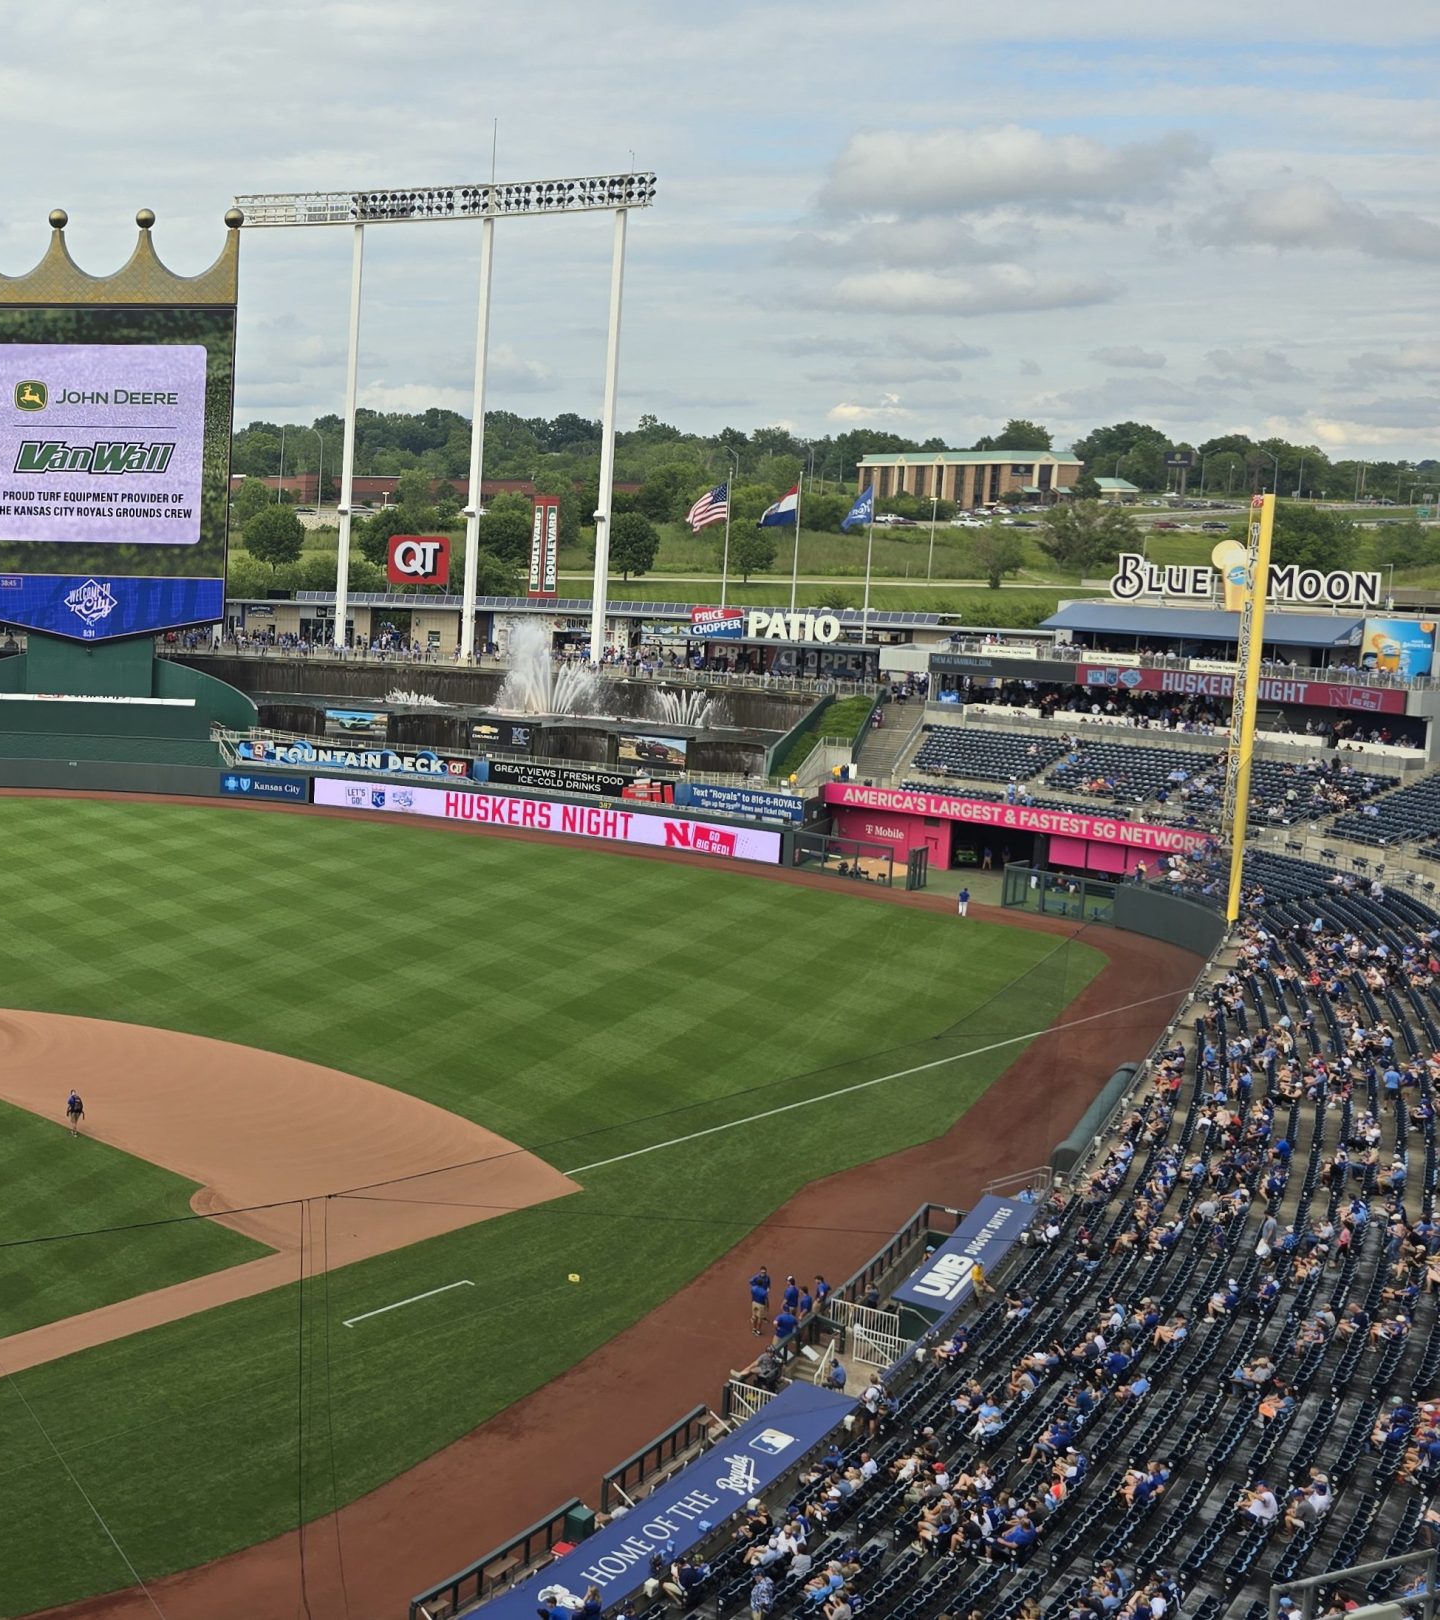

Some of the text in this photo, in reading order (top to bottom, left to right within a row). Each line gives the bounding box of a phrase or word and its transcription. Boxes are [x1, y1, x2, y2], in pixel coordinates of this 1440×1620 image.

[55, 389, 179, 405] JOHN DEERE
[2, 490, 184, 503] PROUD TURF EQUIPMENT PROVIDER OF
[13, 506, 51, 516] KANSAS
[53, 506, 75, 516] CITY
[76, 507, 113, 517] ROYALS
[115, 507, 162, 518] GROUNDS
[164, 508, 192, 519] CREW
[393, 540, 442, 577] QT
[531, 512, 542, 584] BOULEVARD
[546, 512, 558, 585] BOULEVARD
[1110, 553, 1382, 605] BLUE MOON
[69, 586, 101, 602] WELCOME
[81, 596, 112, 618] City
[694, 609, 725, 623] PRICE
[692, 620, 742, 635] CHOPPER
[747, 611, 841, 643] PATIO
[945, 656, 953, 664] AT
[275, 746, 382, 769] FOUNTAIN
[388, 753, 446, 774] DECK
[494, 763, 624, 786] GREAT VIEWS FRESH FOOD
[518, 775, 601, 792] ICE-COLD DRINKS
[254, 781, 301, 795] Kansas City
[347, 788, 366, 798] LET'S
[372, 791, 386, 806] KC
[692, 787, 708, 798] Text
[709, 788, 741, 802] "Royals"
[741, 794, 750, 803] to
[751, 796, 802, 810] 816-6-ROYALS
[445, 790, 552, 829] HUSKERS
[561, 806, 634, 840] NIGHT
[843, 788, 1206, 851] AMERICA'S LARGEST & FASTEST 5G NETWORK
[664, 820, 691, 847] N
[709, 831, 720, 842] GO
[874, 826, 905, 840] Mobile
[696, 840, 730, 856] BIG RED!
[963, 1206, 1014, 1256] DUGOUT SUITES
[912, 1252, 975, 1298] UMB
[580, 1454, 761, 1588] HOME OF THE Royals
